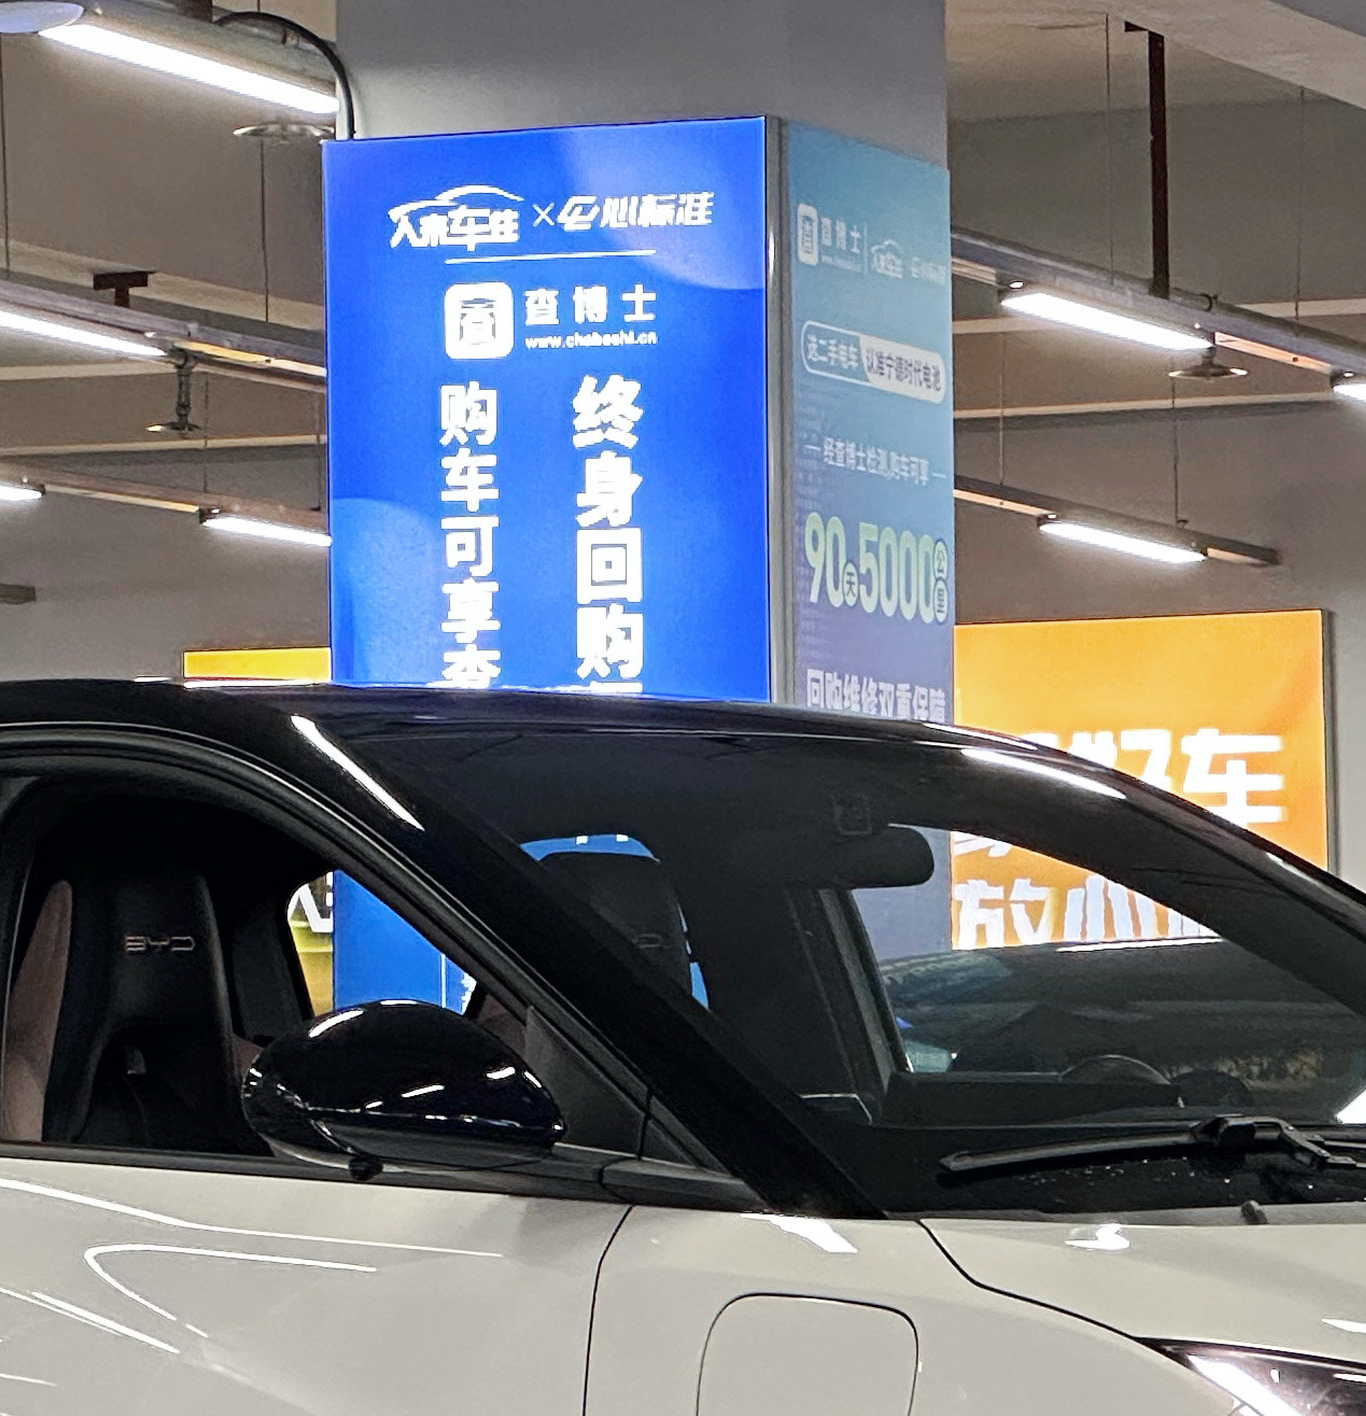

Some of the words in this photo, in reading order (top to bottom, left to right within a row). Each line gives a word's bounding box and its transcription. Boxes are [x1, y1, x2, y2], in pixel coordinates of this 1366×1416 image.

[524, 283, 657, 325] 查博士
[572, 374, 643, 693] 终身回购
